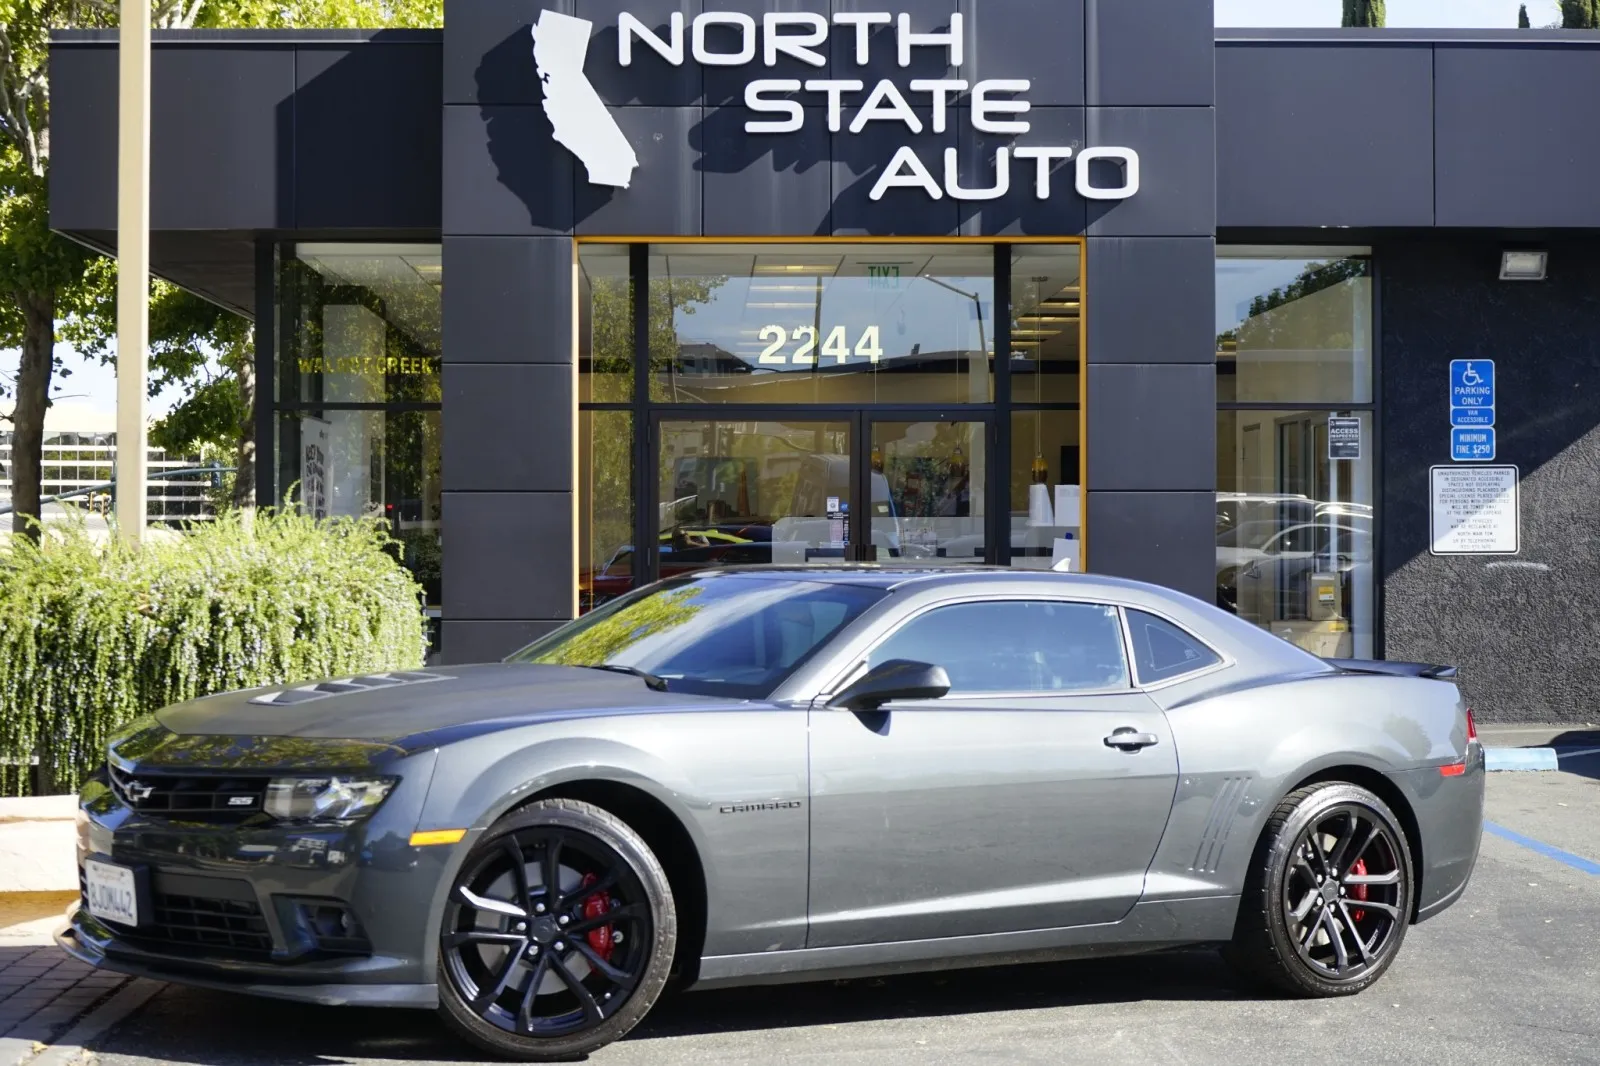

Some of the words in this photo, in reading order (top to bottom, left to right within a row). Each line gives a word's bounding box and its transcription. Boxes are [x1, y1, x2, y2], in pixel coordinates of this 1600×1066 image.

[618, 11, 963, 66] NORTH
[744, 79, 1031, 133] STATE
[869, 146, 1140, 200] AUTO
[758, 324, 883, 364] 2244
[376, 356, 432, 374] CREEK
[1454, 386, 1490, 395] PARKING
[1461, 397, 1484, 405] ONLY
[1460, 434, 1486, 442] MINIMUM
[1456, 444, 1470, 454] FINE
[1473, 444, 1490, 454] $250
[228, 796, 254, 805] SS
[720, 801, 801, 814] CAMARO
